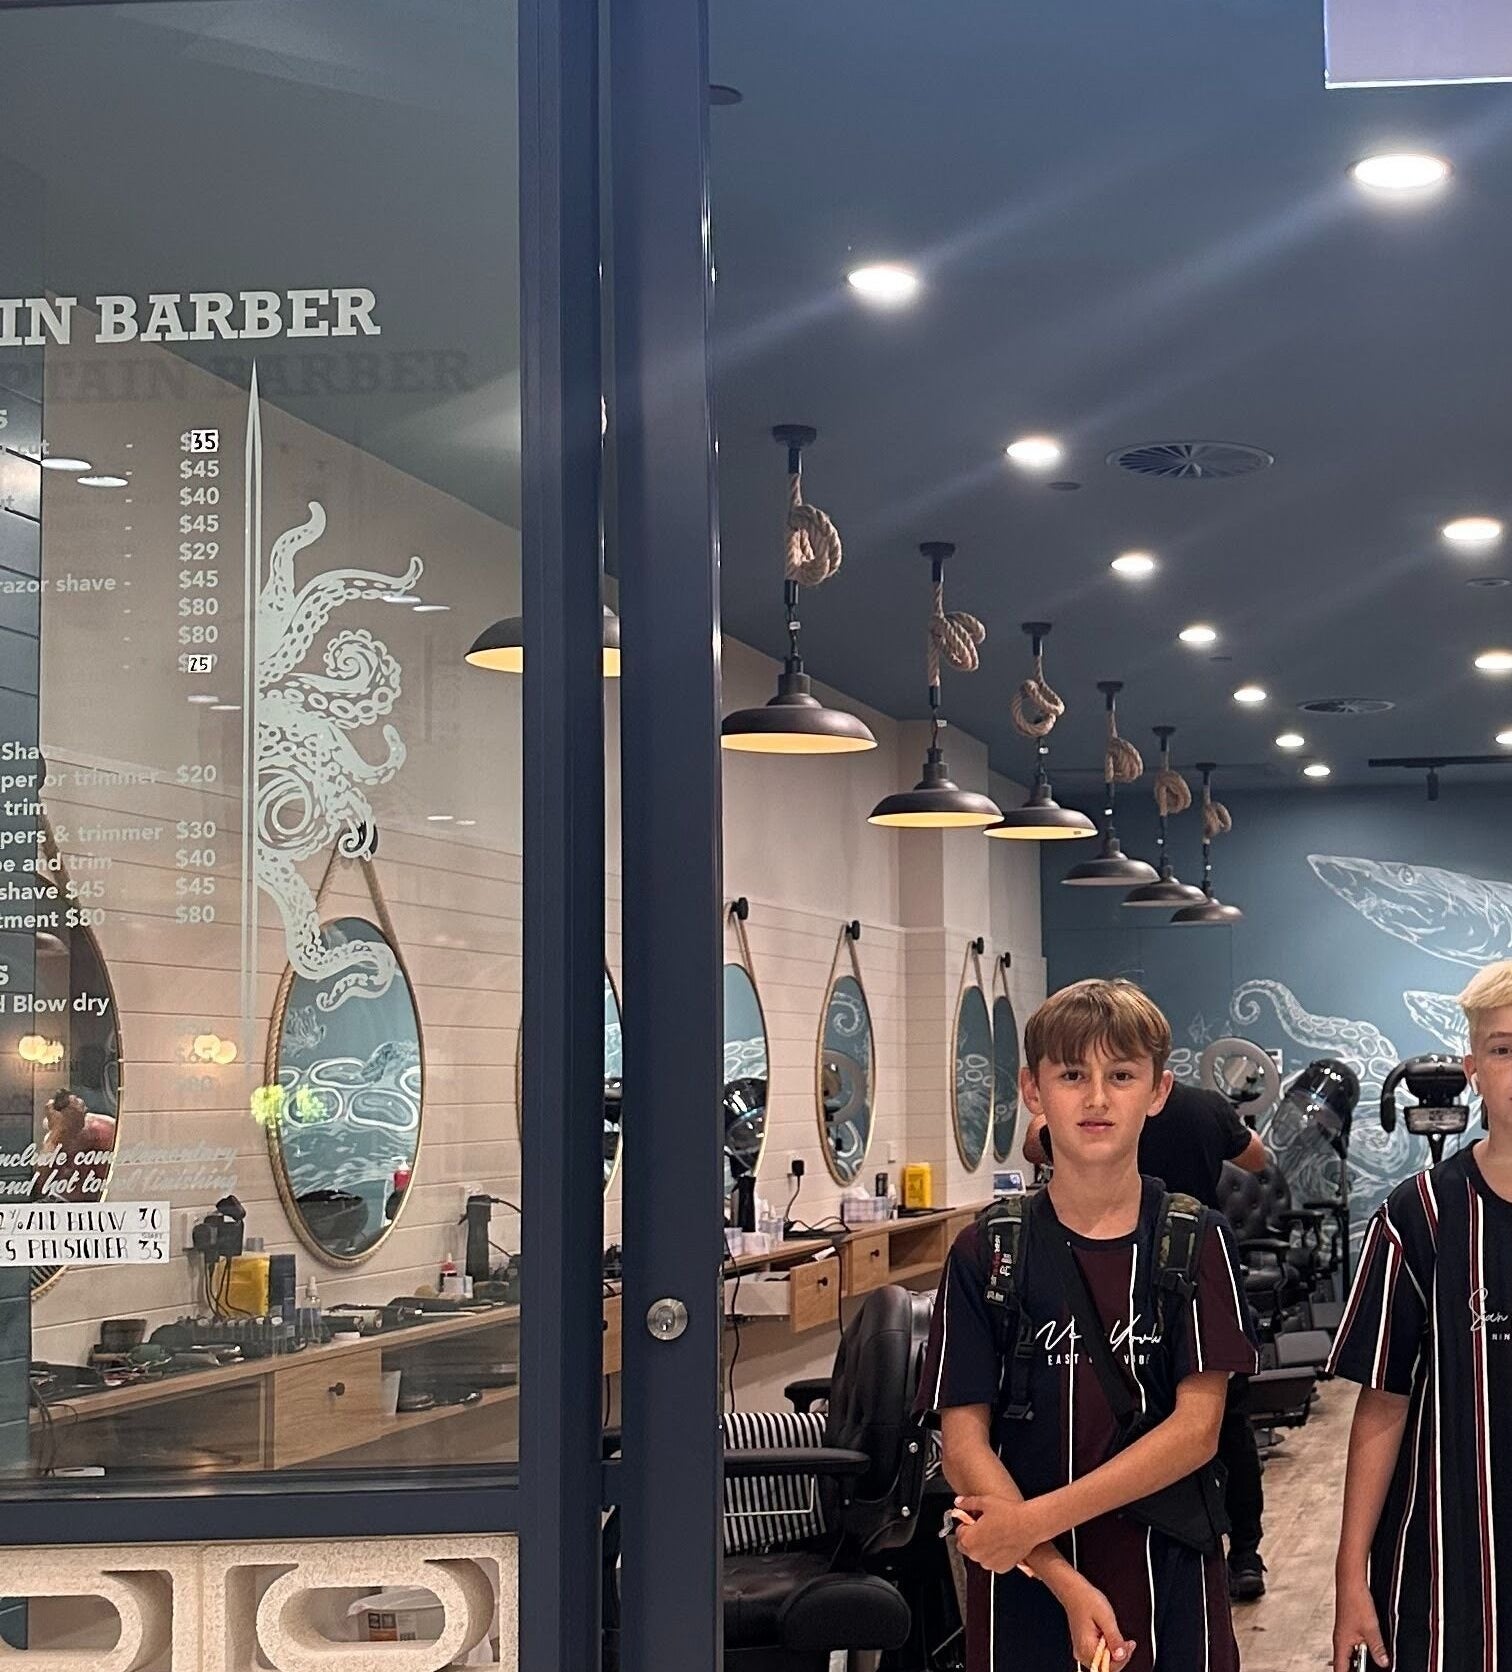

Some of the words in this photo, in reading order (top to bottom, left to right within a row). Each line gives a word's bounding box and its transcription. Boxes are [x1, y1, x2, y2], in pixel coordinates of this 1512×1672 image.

[94, 287, 382, 345] BARBER
[179, 459, 219, 479] $45
[179, 486, 220, 506] $40
[179, 513, 219, 534] $45
[178, 542, 219, 562] $29
[56, 573, 117, 592] shave
[178, 569, 219, 590] $45
[178, 597, 219, 617] $80
[178, 625, 219, 645] $80
[45, 773, 66, 787] or
[74, 769, 161, 787] trimmer
[176, 764, 218, 784] $20
[3, 798, 48, 817] trim
[53, 825, 70, 842] &
[78, 826, 164, 842] trimmer
[176, 820, 217, 840] $30
[22, 852, 62, 872] and
[69, 853, 113, 871] trim
[175, 849, 217, 868] $40
[0, 881, 59, 900] shave
[65, 879, 106, 900] $45
[175, 877, 216, 897] $45
[65, 907, 106, 929] $80
[175, 904, 216, 925] $80
[13, 993, 68, 1013] Blow
[72, 991, 110, 1017] dry
[0, 1142, 68, 1168] nclude
[41, 1168, 80, 1195] hot
[137, 1207, 163, 1231] 30
[28, 1236, 129, 1261] PENSIONER
[137, 1238, 165, 1261] 35
[1468, 1286, 1509, 1332] San
[1047, 1353, 1080, 1366] EAST
